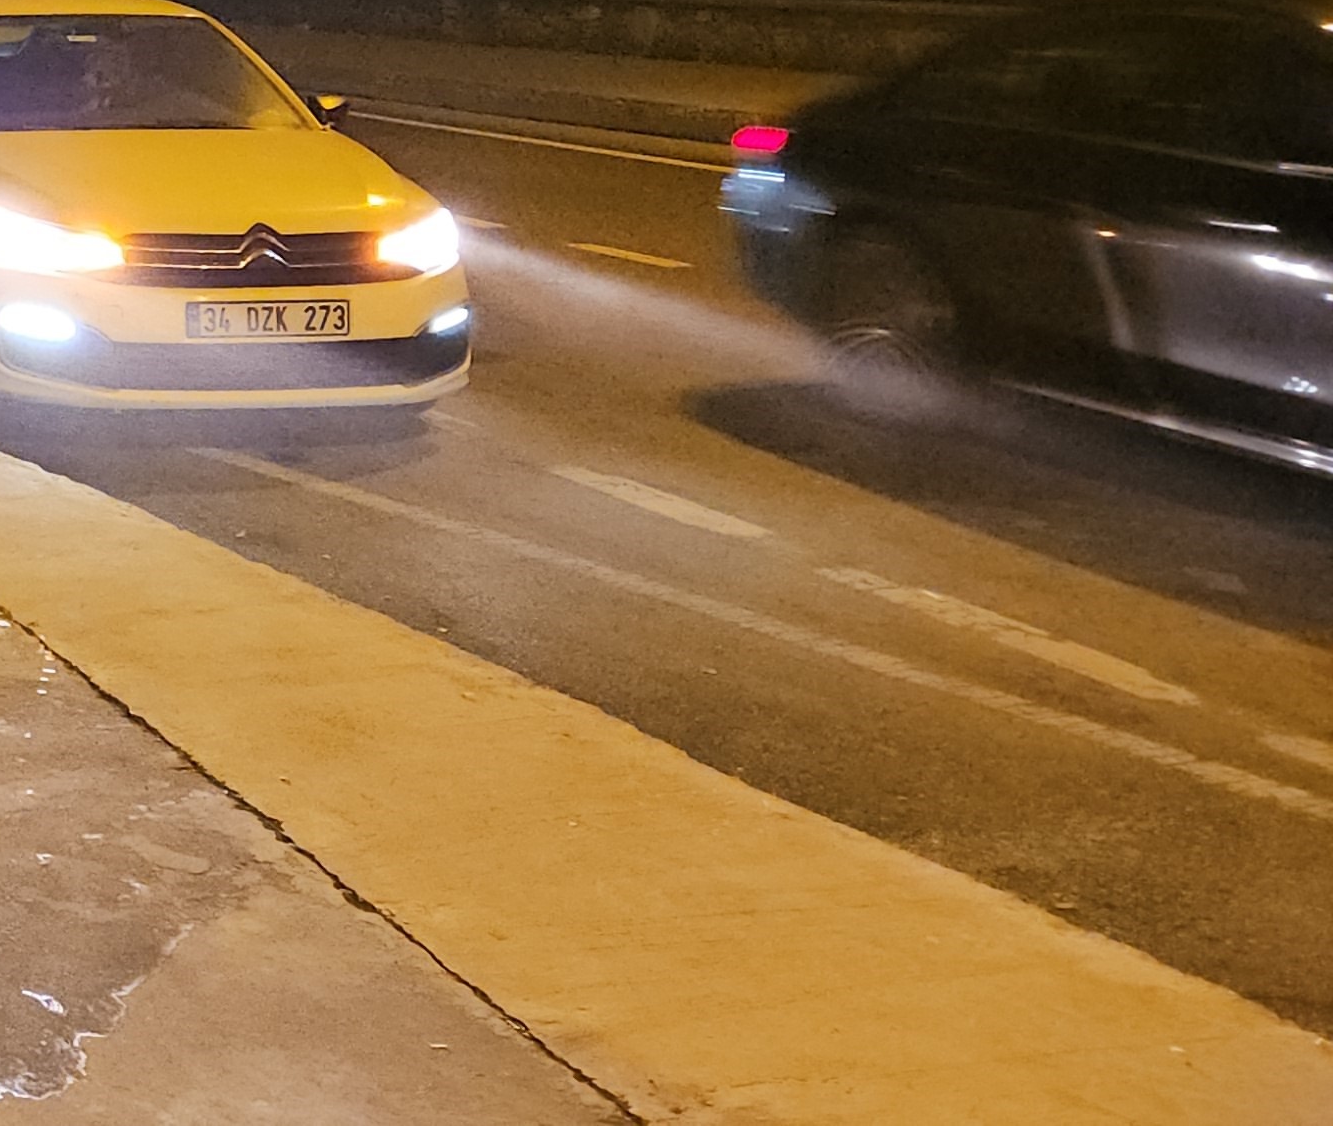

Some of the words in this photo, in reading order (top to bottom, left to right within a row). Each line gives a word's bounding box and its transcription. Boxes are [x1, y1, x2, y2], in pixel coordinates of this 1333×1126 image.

[203, 307, 230, 332] 34
[247, 306, 288, 332] DZK
[304, 304, 346, 331] 273
